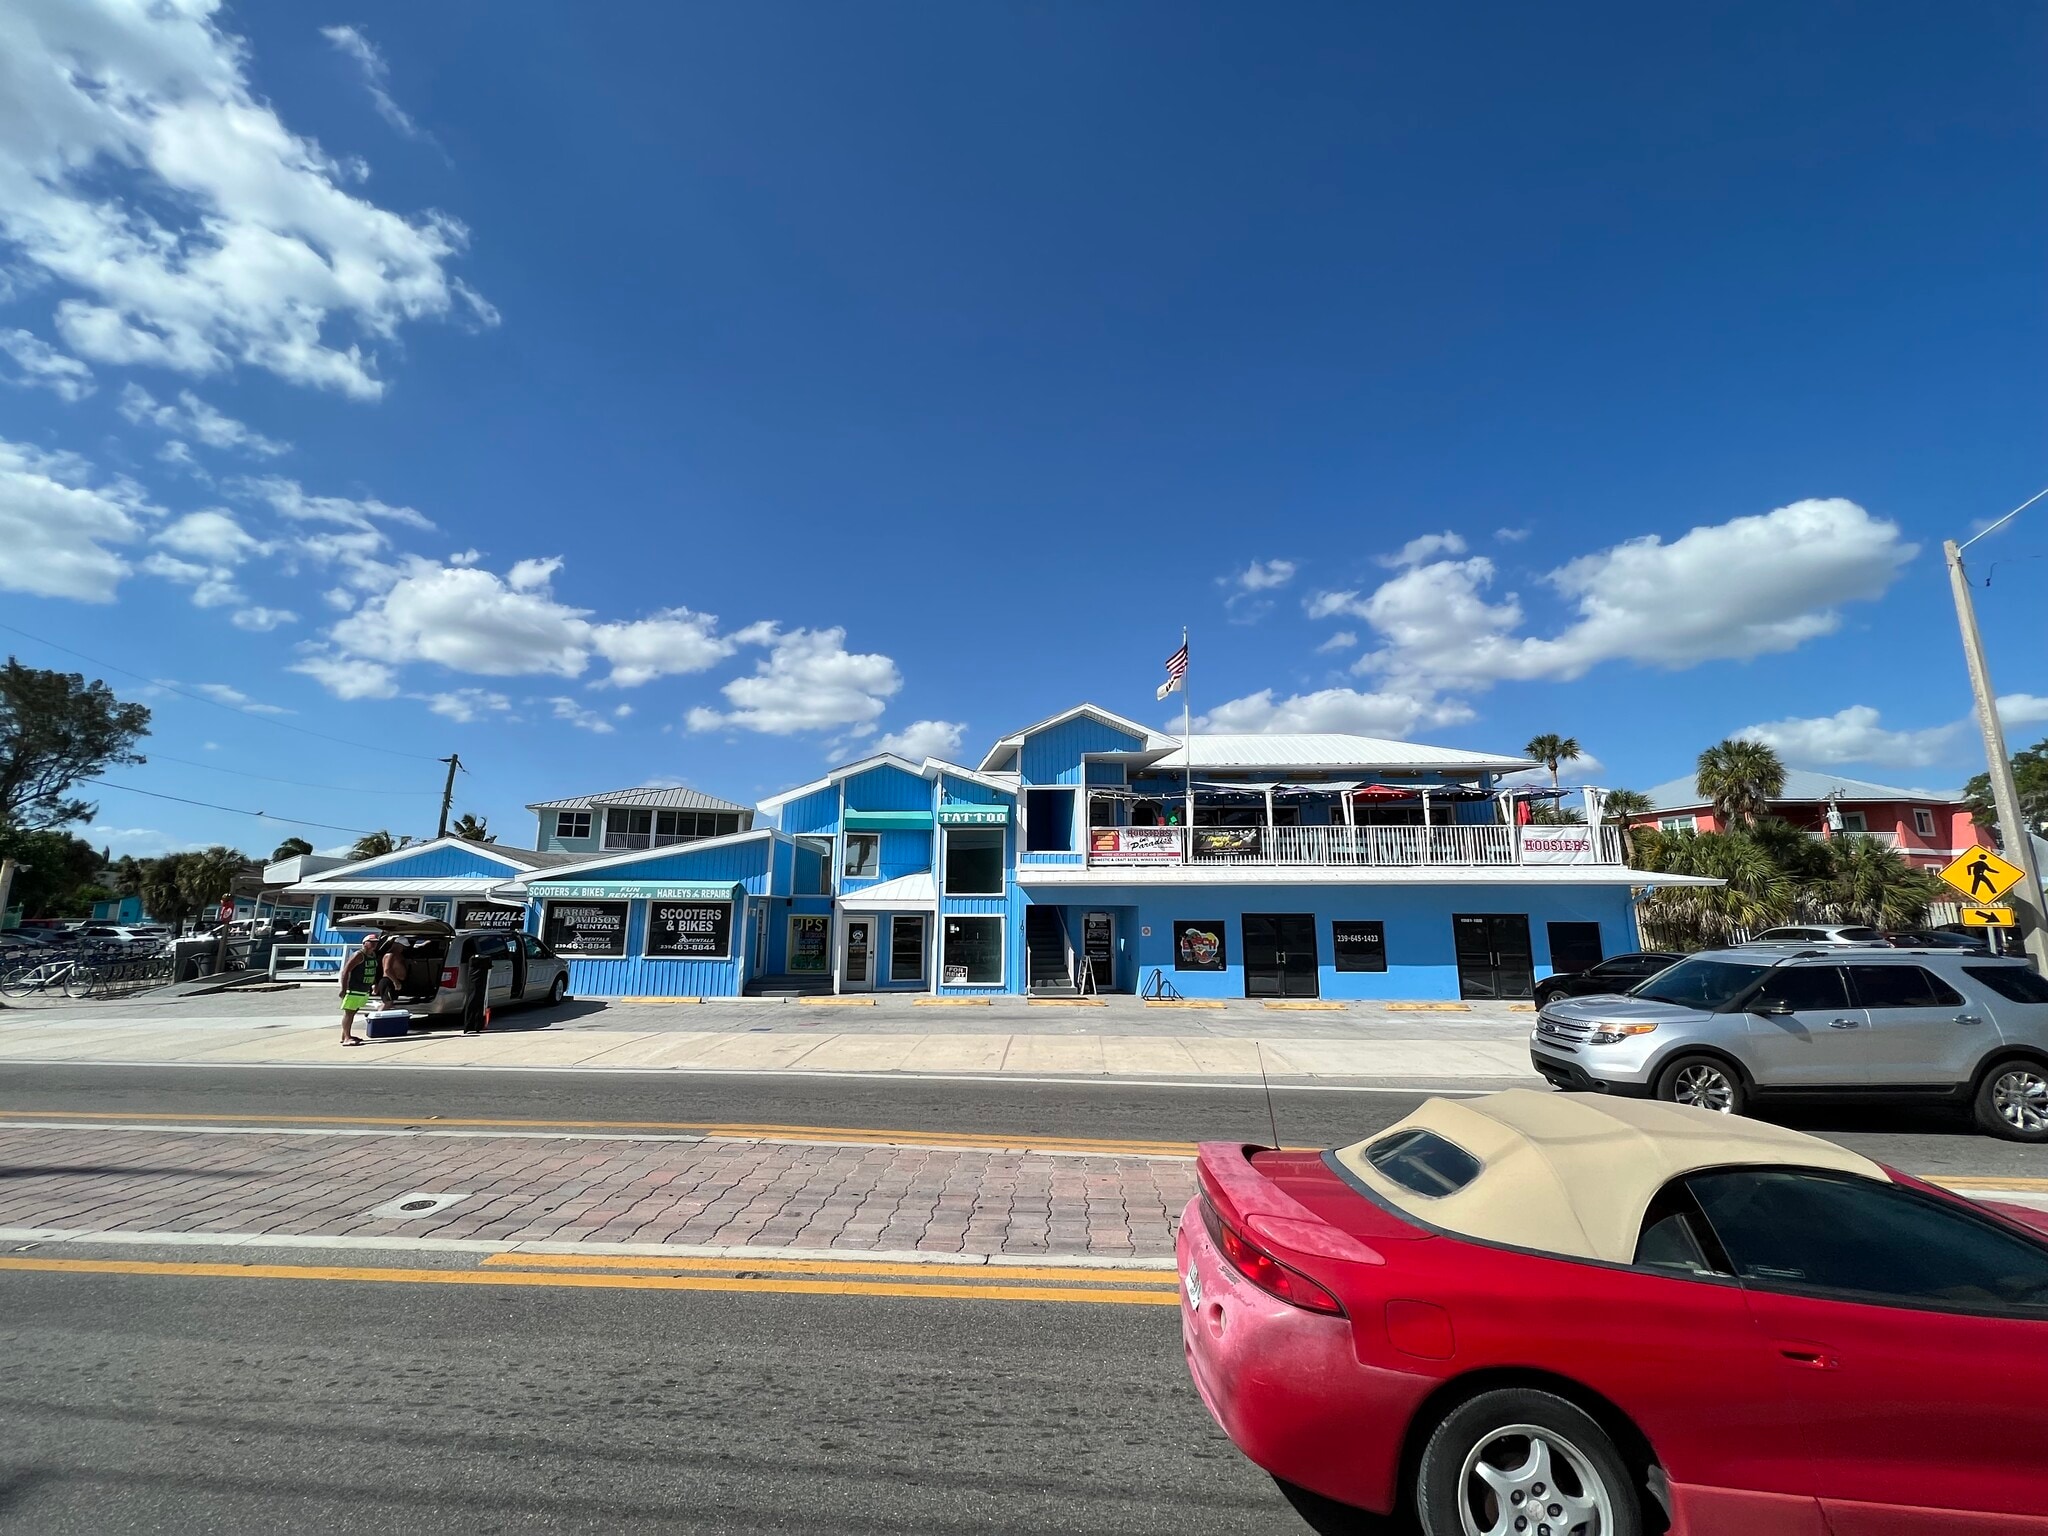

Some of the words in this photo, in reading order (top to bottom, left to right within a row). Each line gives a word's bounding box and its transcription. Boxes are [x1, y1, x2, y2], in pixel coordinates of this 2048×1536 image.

[940, 812, 1006, 823] TATTOO
[1524, 839, 1591, 852] HOOSIERS
[529, 887, 570, 896] SCOOTERS
[581, 887, 605, 897] BIKES
[656, 889, 691, 898] HARLEYS
[701, 889, 730, 898] REPAIRS
[465, 911, 526, 921] RENTALS
[660, 908, 722, 920] SCOOTERS
[564, 915, 621, 927] DAVIDSON
[666, 920, 675, 931] &
[678, 920, 714, 932] BIKES
